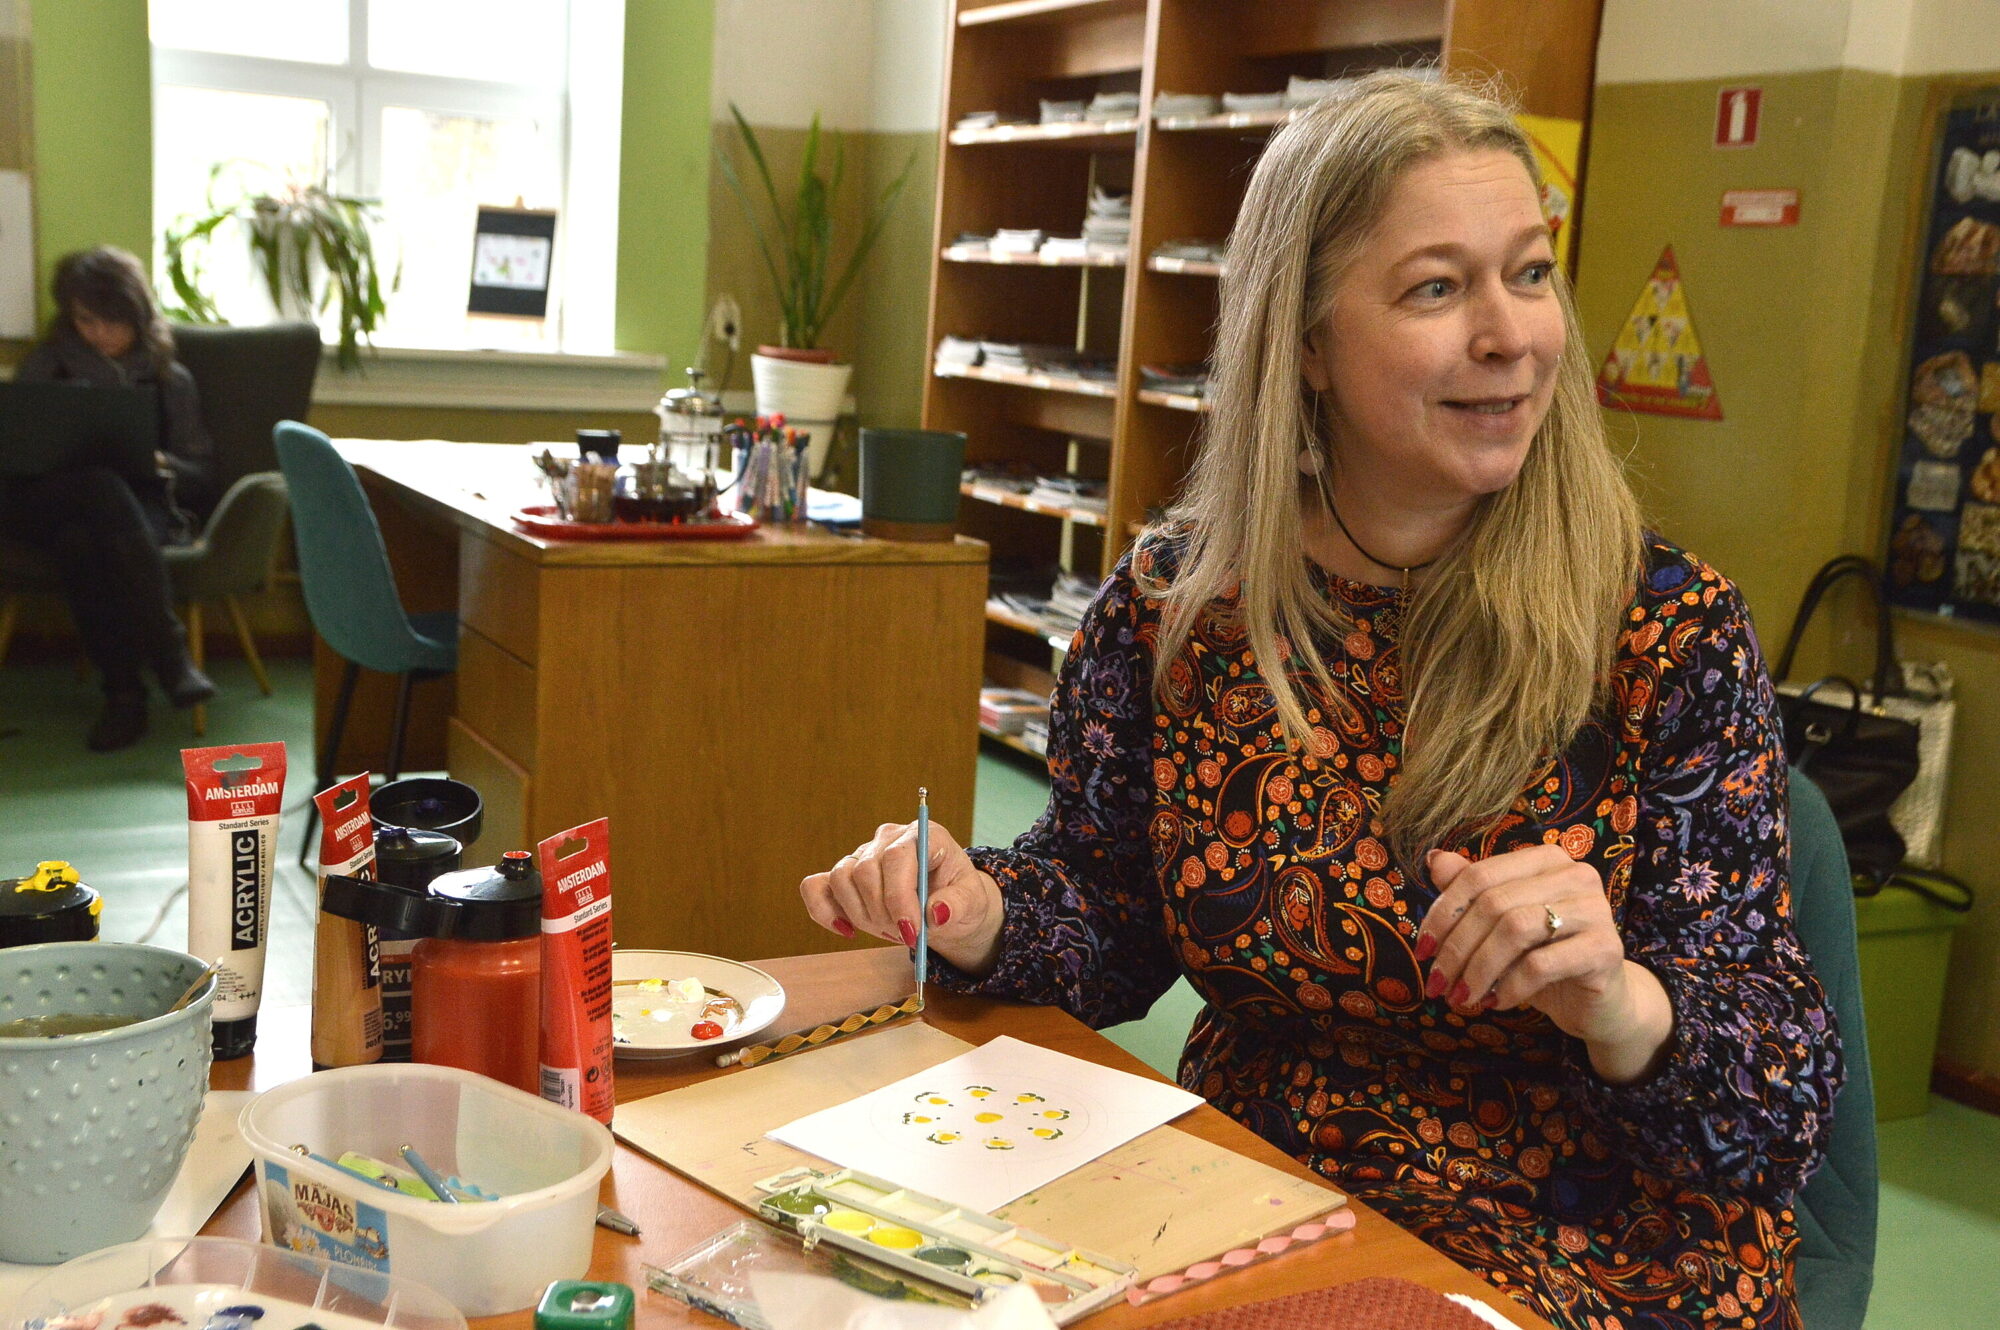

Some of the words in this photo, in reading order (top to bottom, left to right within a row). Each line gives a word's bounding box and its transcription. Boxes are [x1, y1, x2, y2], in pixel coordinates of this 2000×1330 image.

[205, 782, 279, 801] AMSTERDAM
[219, 820, 249, 830] Standard
[249, 819, 269, 827] Series
[334, 811, 371, 842] AMSTERDAM
[236, 837, 255, 942] ACRYLIC
[557, 860, 607, 895] AMSTERDAM
[574, 908, 593, 923] Standard
[593, 901, 608, 913] Series
